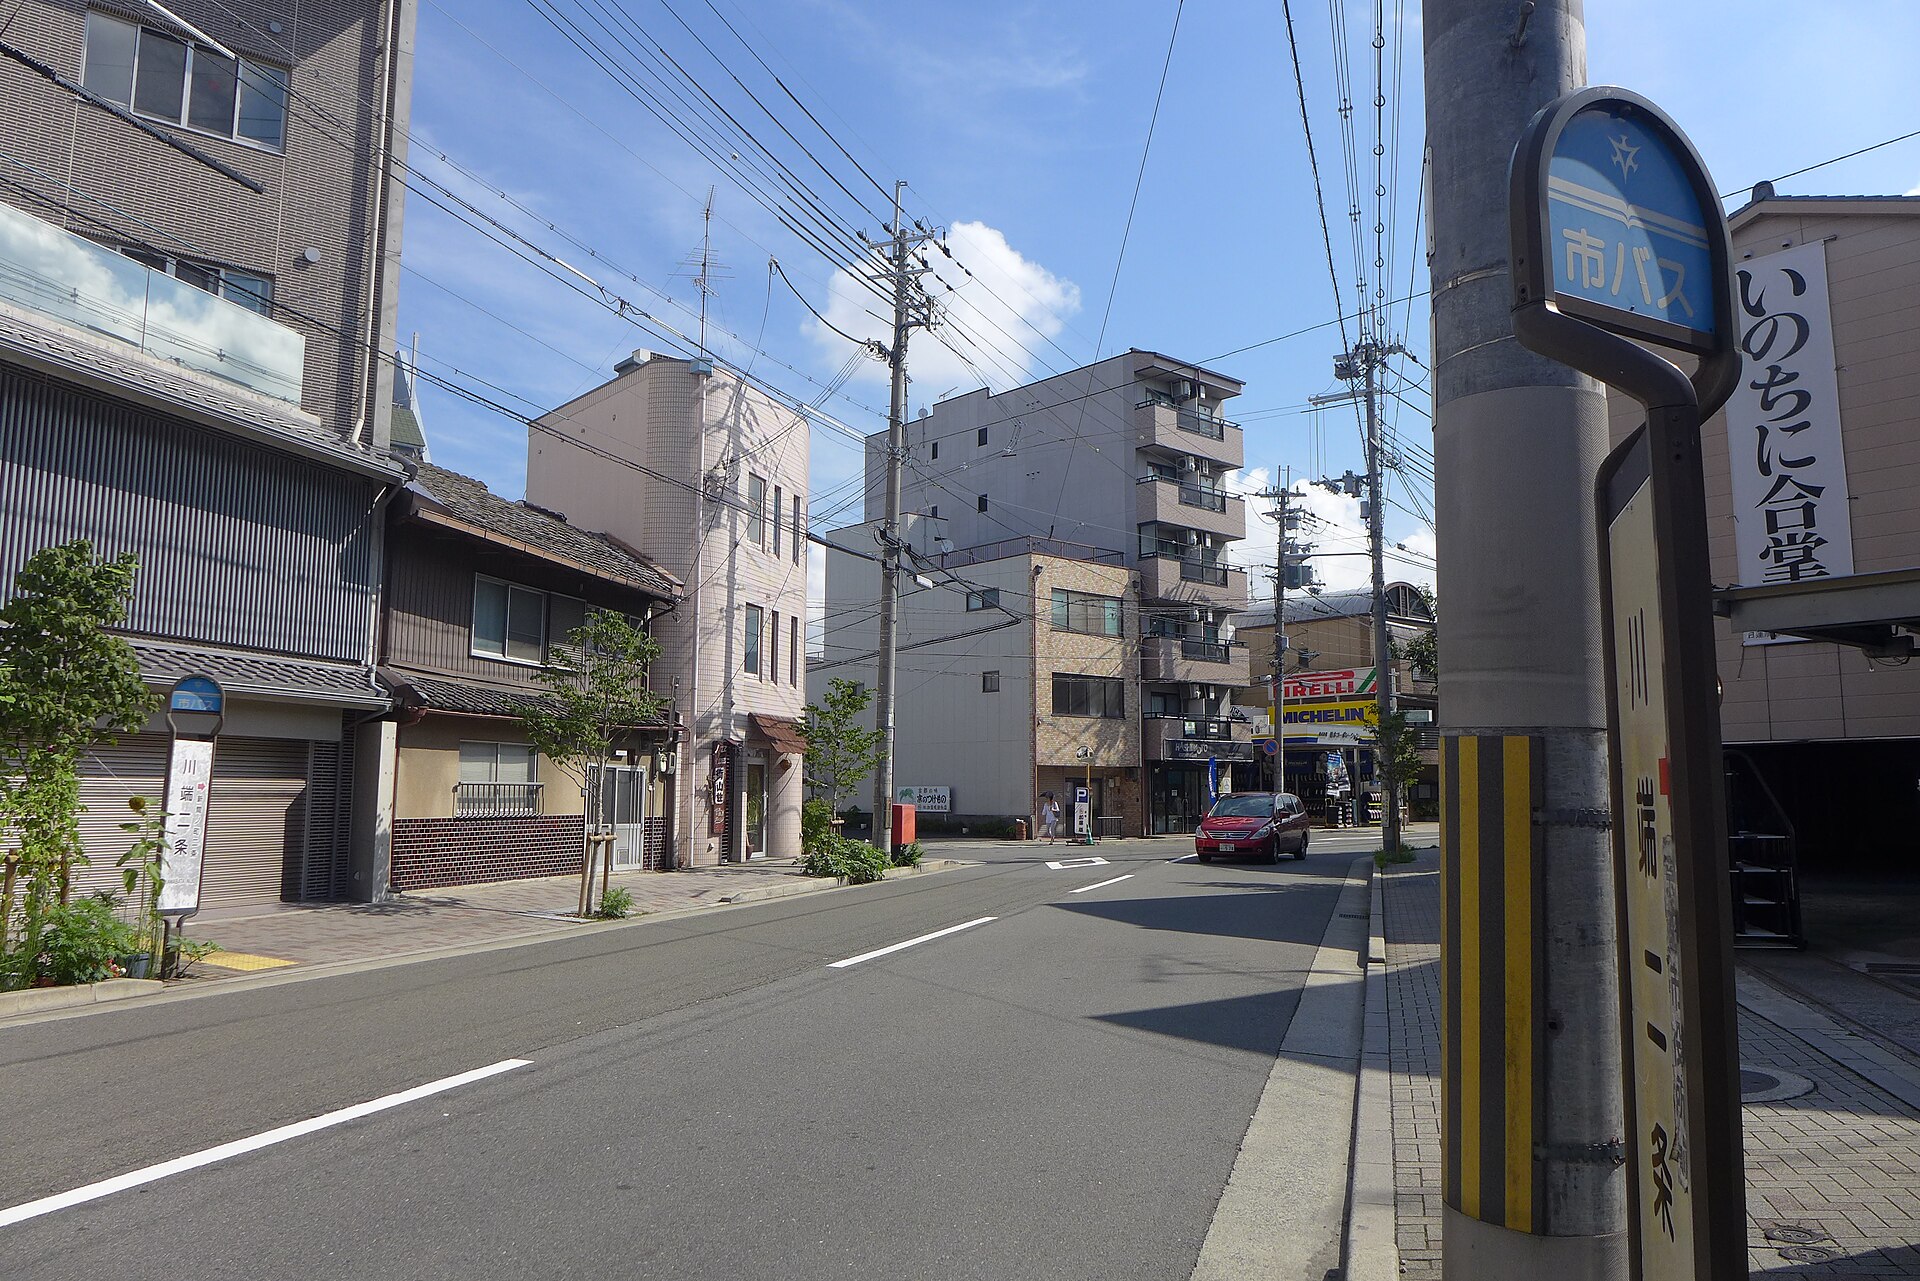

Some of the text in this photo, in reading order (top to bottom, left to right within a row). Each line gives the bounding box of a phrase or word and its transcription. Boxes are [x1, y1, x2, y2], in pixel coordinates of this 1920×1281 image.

[1562, 227, 1694, 318] 市バス
[1735, 266, 1831, 584] いのちに合掌
[177, 698, 215, 711] 市バス
[1274, 681, 1354, 699] IRELLI
[174, 759, 198, 856] 川端二条
[1076, 789, 1087, 802] P
[1627, 606, 1676, 1244] 川端二条
